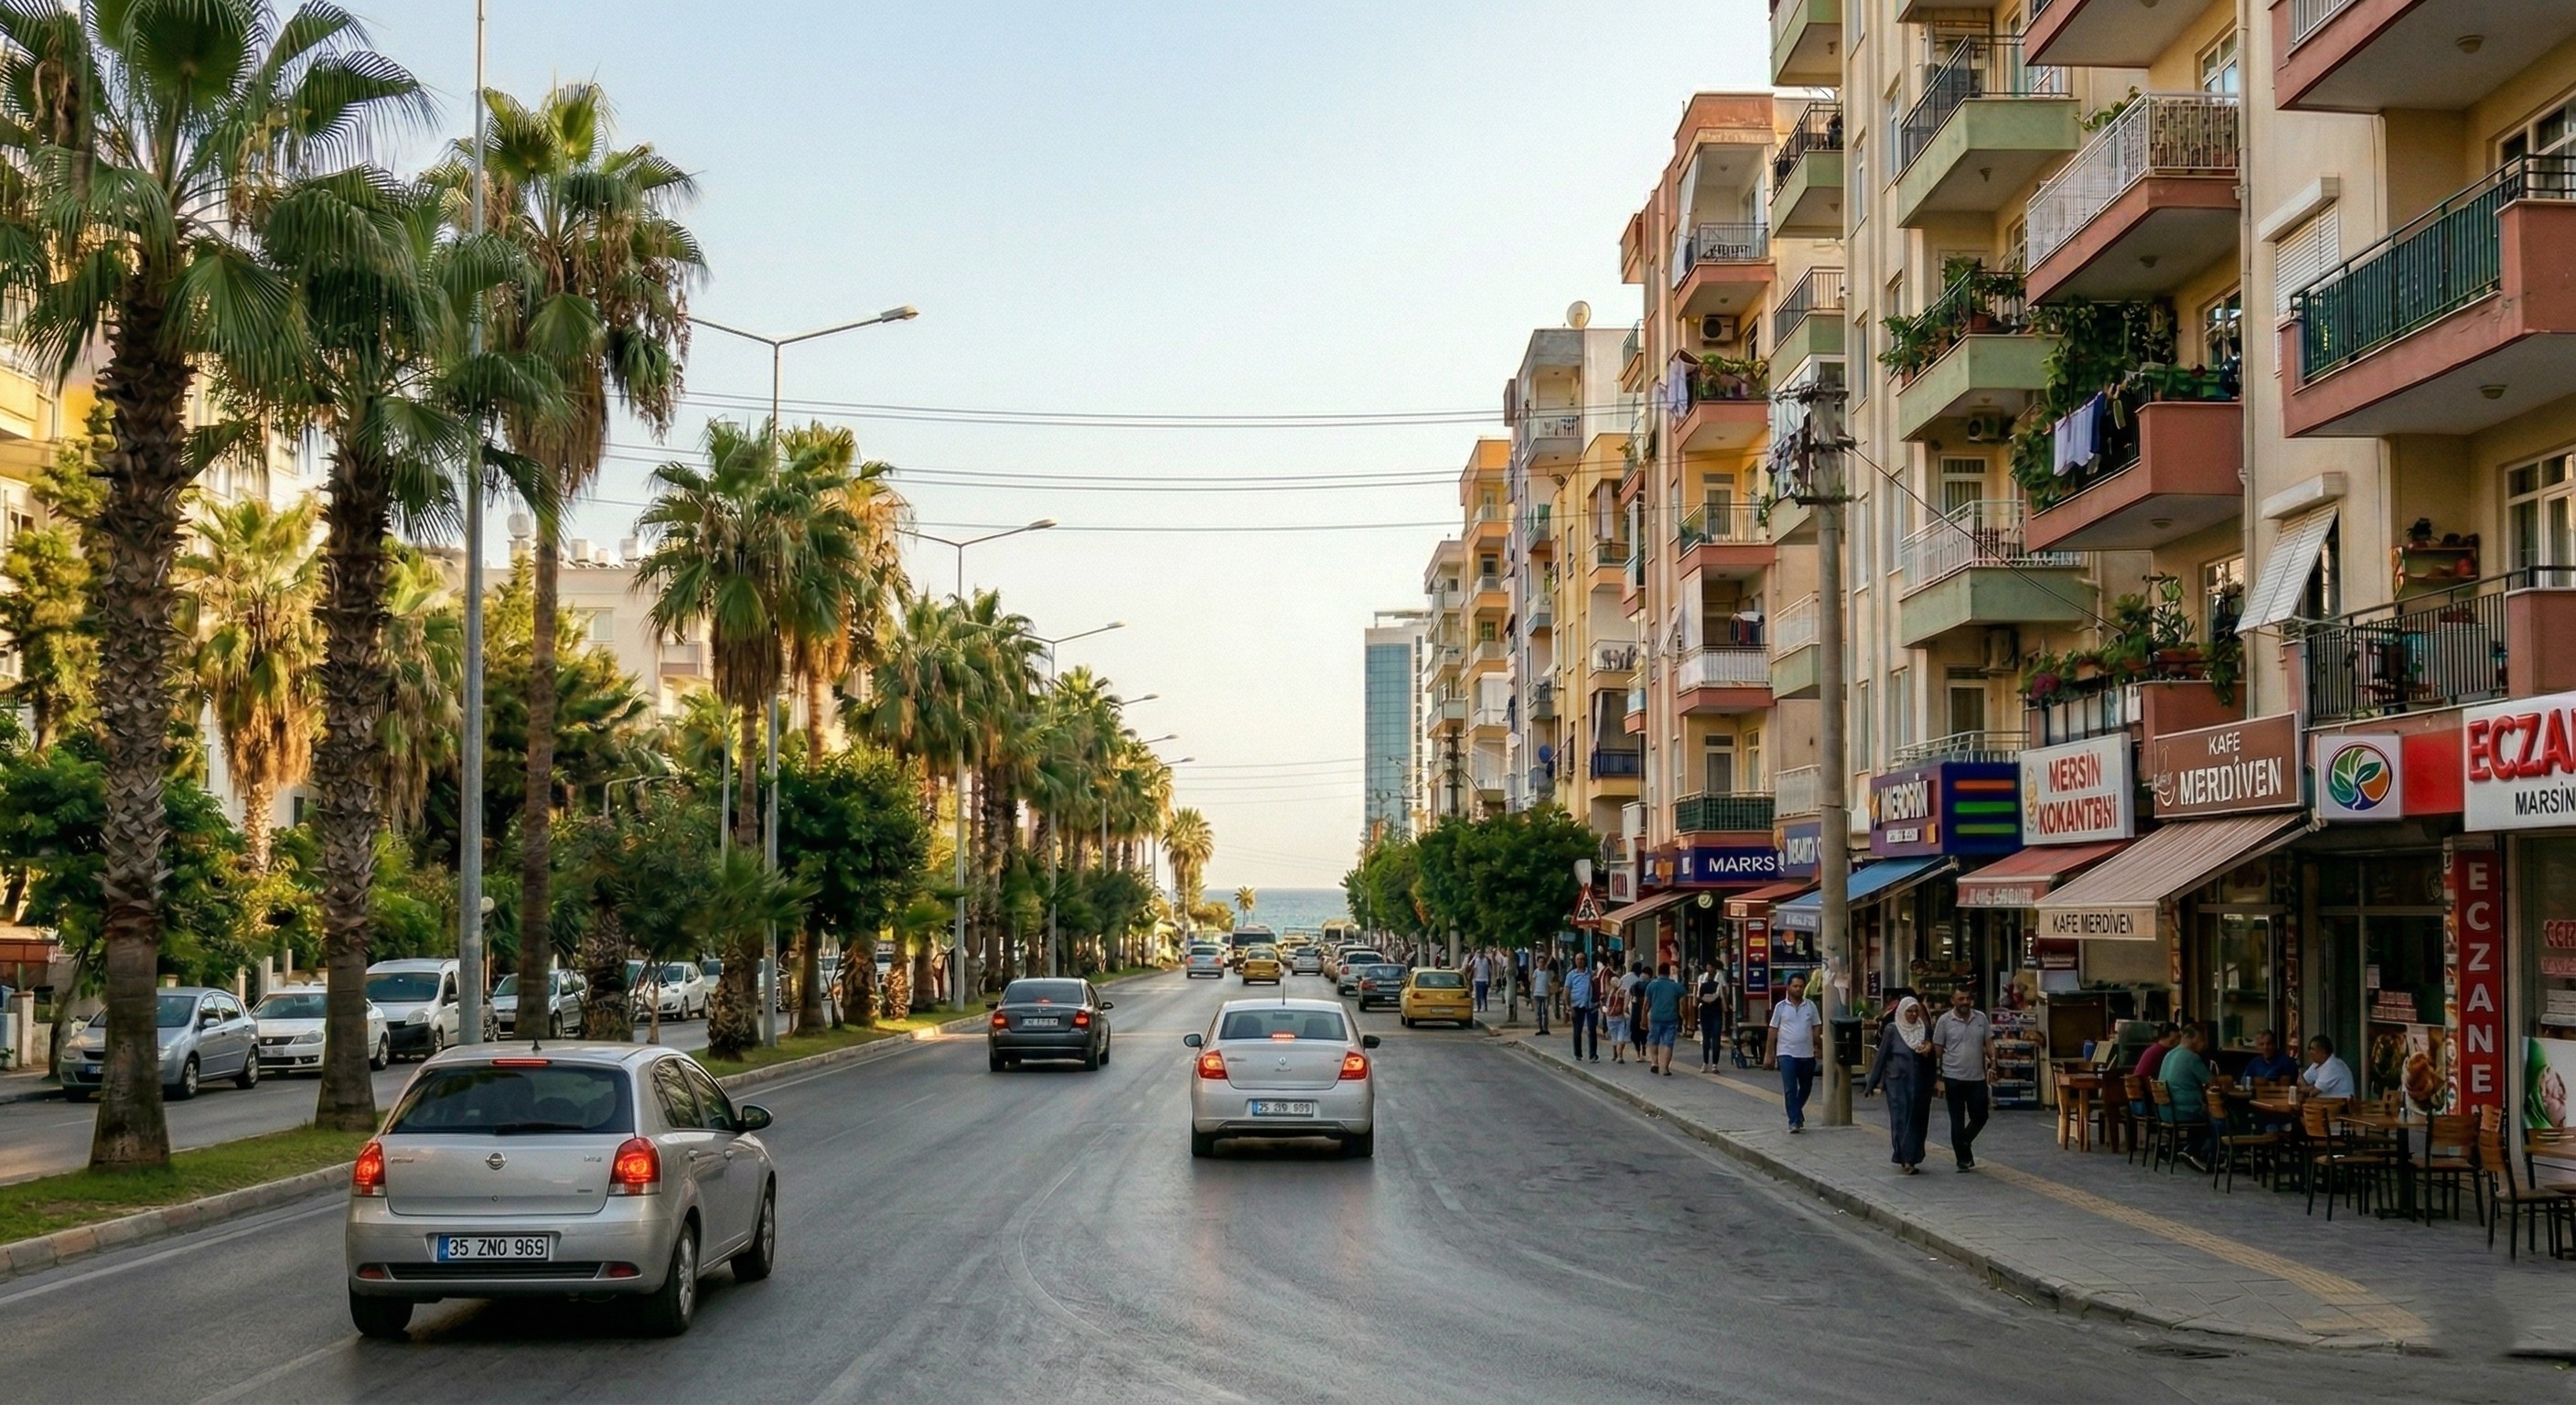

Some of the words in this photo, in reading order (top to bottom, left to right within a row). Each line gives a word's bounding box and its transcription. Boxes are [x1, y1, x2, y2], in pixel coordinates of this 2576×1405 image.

[2208, 731, 2240, 756] KAFE
[2468, 708, 2576, 782] ECZA
[2048, 749, 2101, 793] MERSİN
[2516, 781, 2576, 815] MARSİN
[1709, 856, 1775, 873] MARRS
[2053, 915, 2078, 934] KAFE
[449, 1239, 468, 1256] 35
